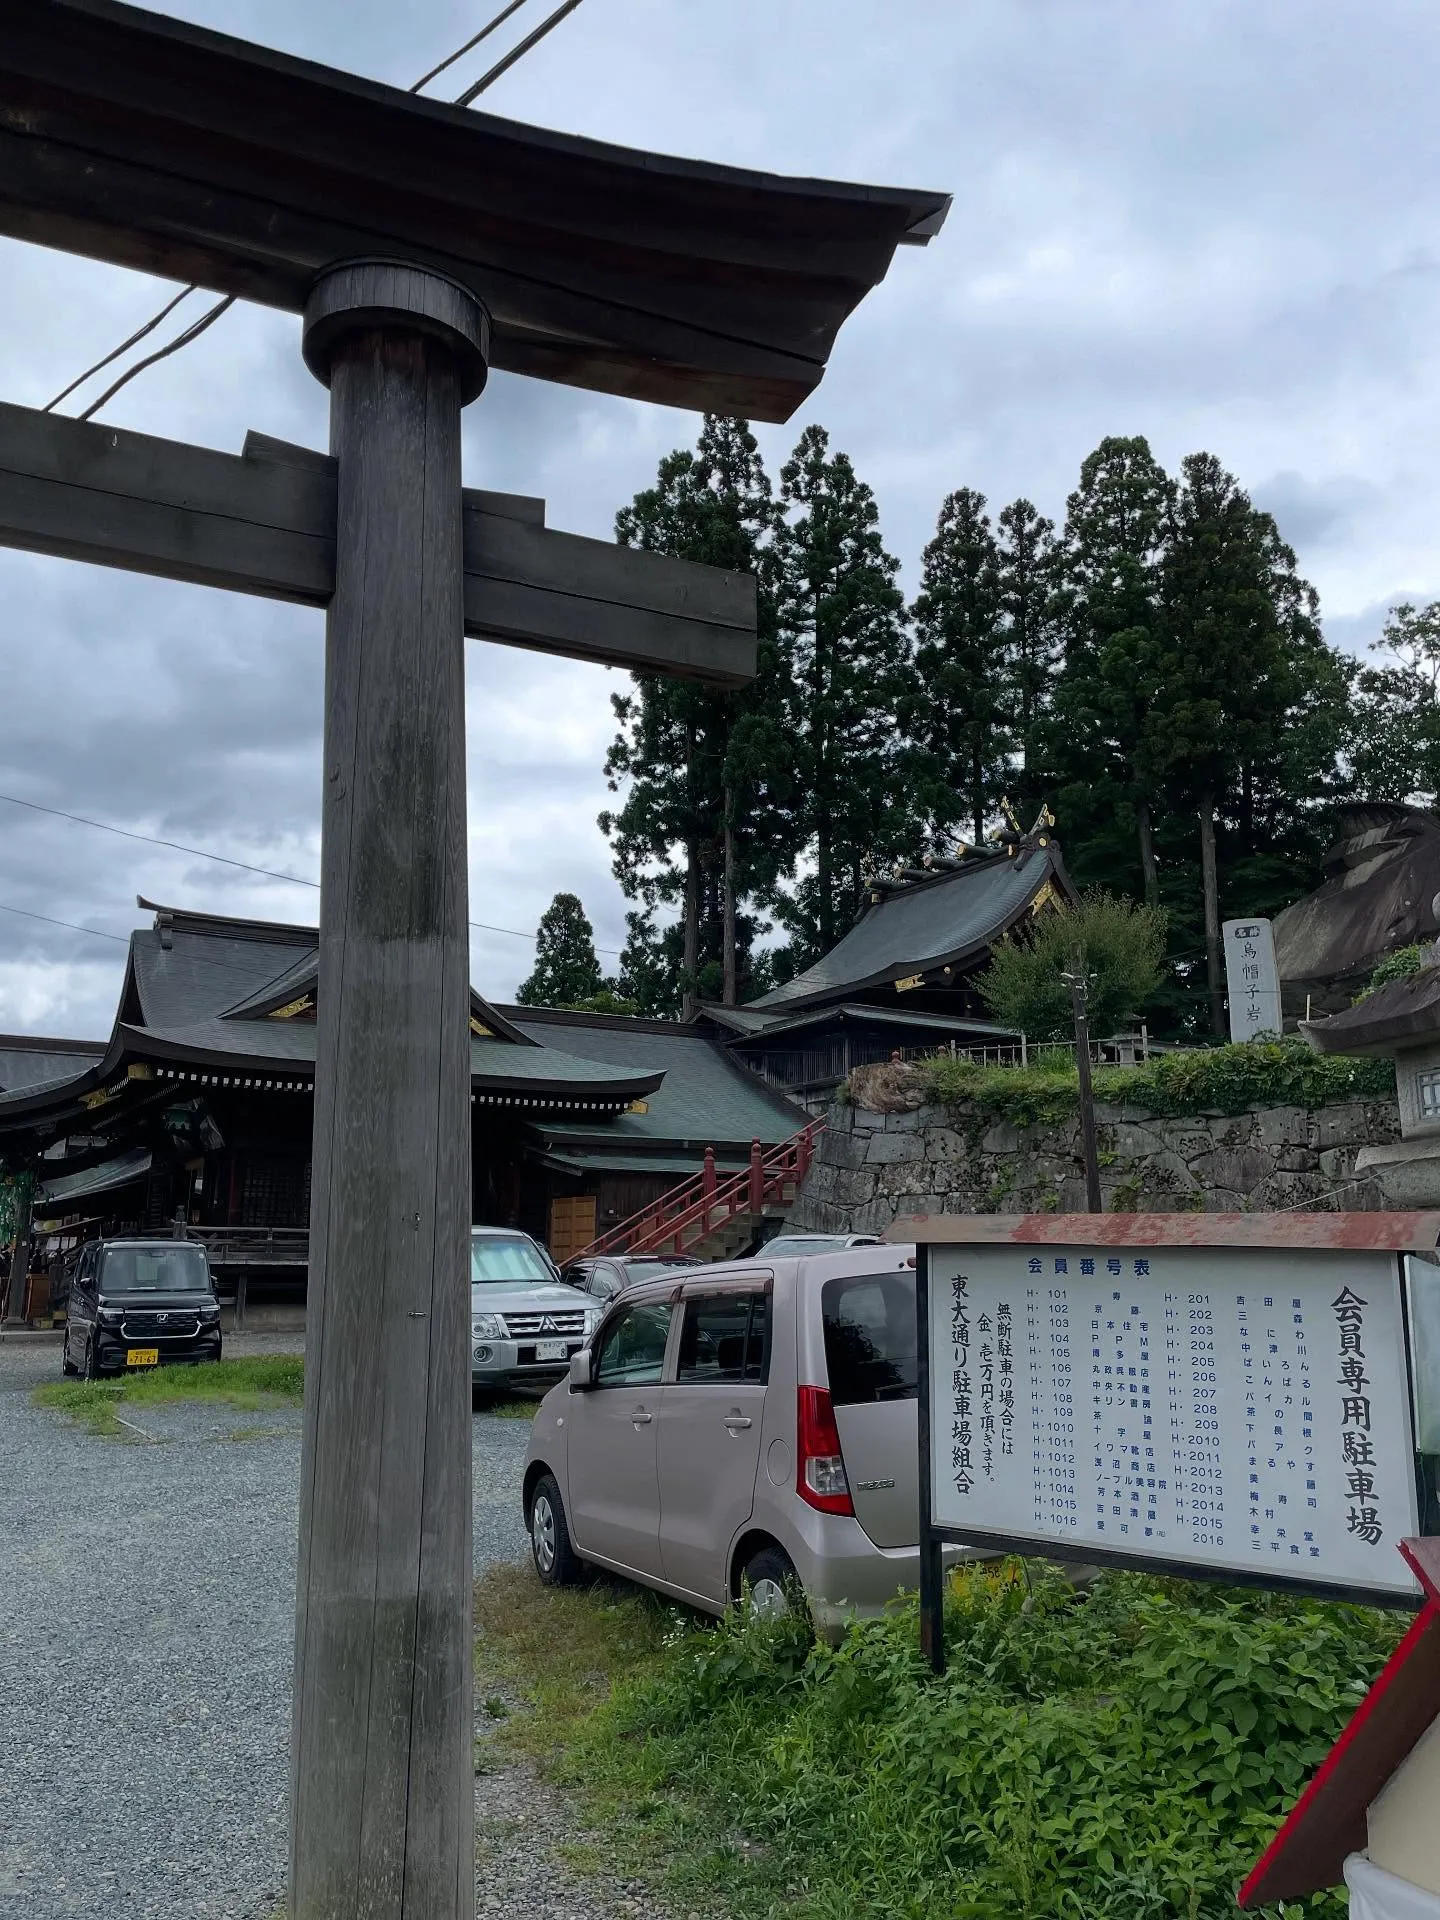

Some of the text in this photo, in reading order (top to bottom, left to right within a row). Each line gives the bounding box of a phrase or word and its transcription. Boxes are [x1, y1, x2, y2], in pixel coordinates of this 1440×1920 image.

[1241, 942, 1261, 1021] 烏帽子岩
[1028, 1257, 1152, 1276] 会員番号表
[1048, 1289, 1066, 1299] 101
[1188, 1294, 1209, 1304] 201
[1049, 1304, 1068, 1314] 102
[1189, 1309, 1212, 1320] 202
[1049, 1318, 1069, 1328] 103
[1238, 1311, 1303, 1324] 三森
[1091, 1320, 1148, 1332] 日本住宅
[1190, 1325, 1214, 1336] 203
[1050, 1333, 1069, 1343] 104
[1190, 1340, 1214, 1351] 204
[1241, 1342, 1307, 1356] 中津川
[1050, 1348, 1070, 1358] 105
[1191, 1356, 1215, 1367] 205
[1243, 1358, 1309, 1371] ばいろん
[1051, 1363, 1072, 1373] 106
[997, 1302, 1015, 1455] 無断駐車の場合には
[1192, 1371, 1216, 1382] 206
[1245, 1375, 1311, 1389] こんばる
[951, 1274, 975, 1494] 東大通り駐車場組合
[1051, 1378, 1071, 1388] 107
[1092, 1380, 1151, 1395] 中央不動産
[1053, 1393, 1073, 1403] 108
[1192, 1388, 1216, 1399] 207
[1245, 1392, 1311, 1406] バイカル
[1092, 1395, 1151, 1409] キリン書房
[1053, 1407, 1073, 1417] 109
[1193, 1403, 1217, 1415] 208
[1330, 1286, 1383, 1545] 会員専用駐車場
[1194, 1419, 1219, 1430] 209
[1249, 1456, 1315, 1472] まるやす
[1096, 1474, 1167, 1490] ノーブル美容院
[1249, 1507, 1274, 1519] 木村
[1192, 1532, 1224, 1546] 2016
[1251, 1540, 1320, 1557] 三平食堂
